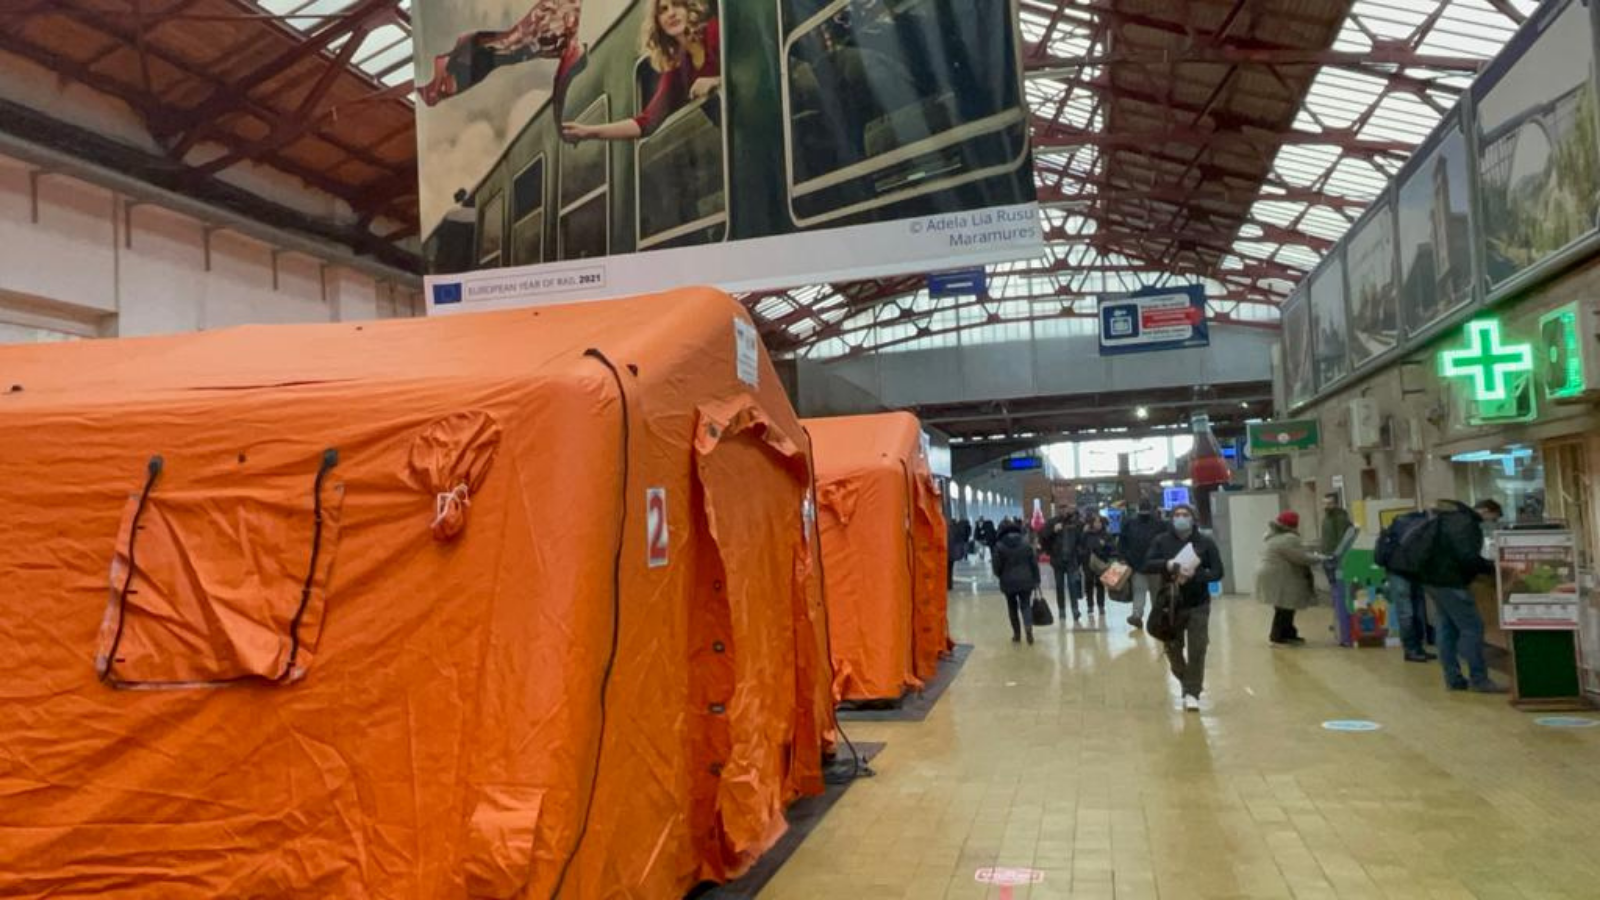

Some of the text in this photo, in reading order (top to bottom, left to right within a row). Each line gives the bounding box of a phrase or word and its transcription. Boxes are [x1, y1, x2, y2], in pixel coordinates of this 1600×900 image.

[926, 216, 967, 231] Adela
[971, 212, 993, 226] Lia
[996, 208, 1034, 221] Rusu
[949, 226, 1036, 246] Maramures
[468, 274, 601, 296] EUROPEAN YEAR OF RAIL 2021
[649, 493, 667, 558] 2
